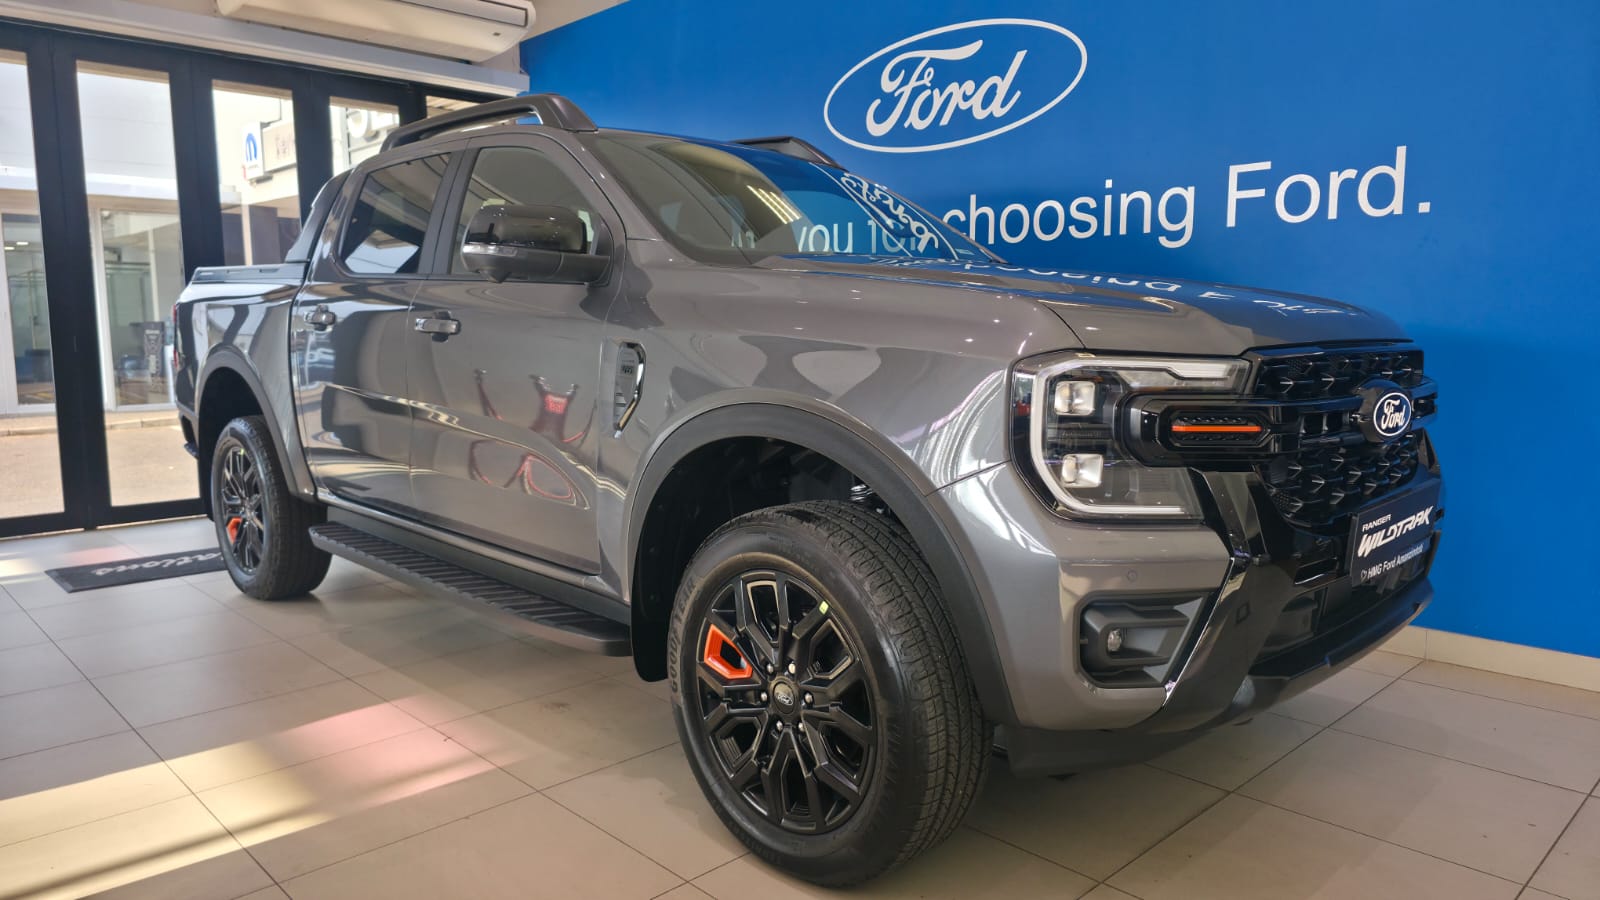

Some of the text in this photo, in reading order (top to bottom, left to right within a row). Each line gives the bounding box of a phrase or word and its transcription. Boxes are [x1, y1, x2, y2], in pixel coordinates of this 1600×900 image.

[866, 39, 1028, 137] Ford
[942, 178, 1195, 249] choosing
[1226, 145, 1432, 228] Ford.
[1381, 398, 1407, 430] Ford
[1357, 505, 1434, 558] WILDTRAK
[1362, 514, 1392, 533] RANGER
[1382, 555, 1397, 572] Ford
